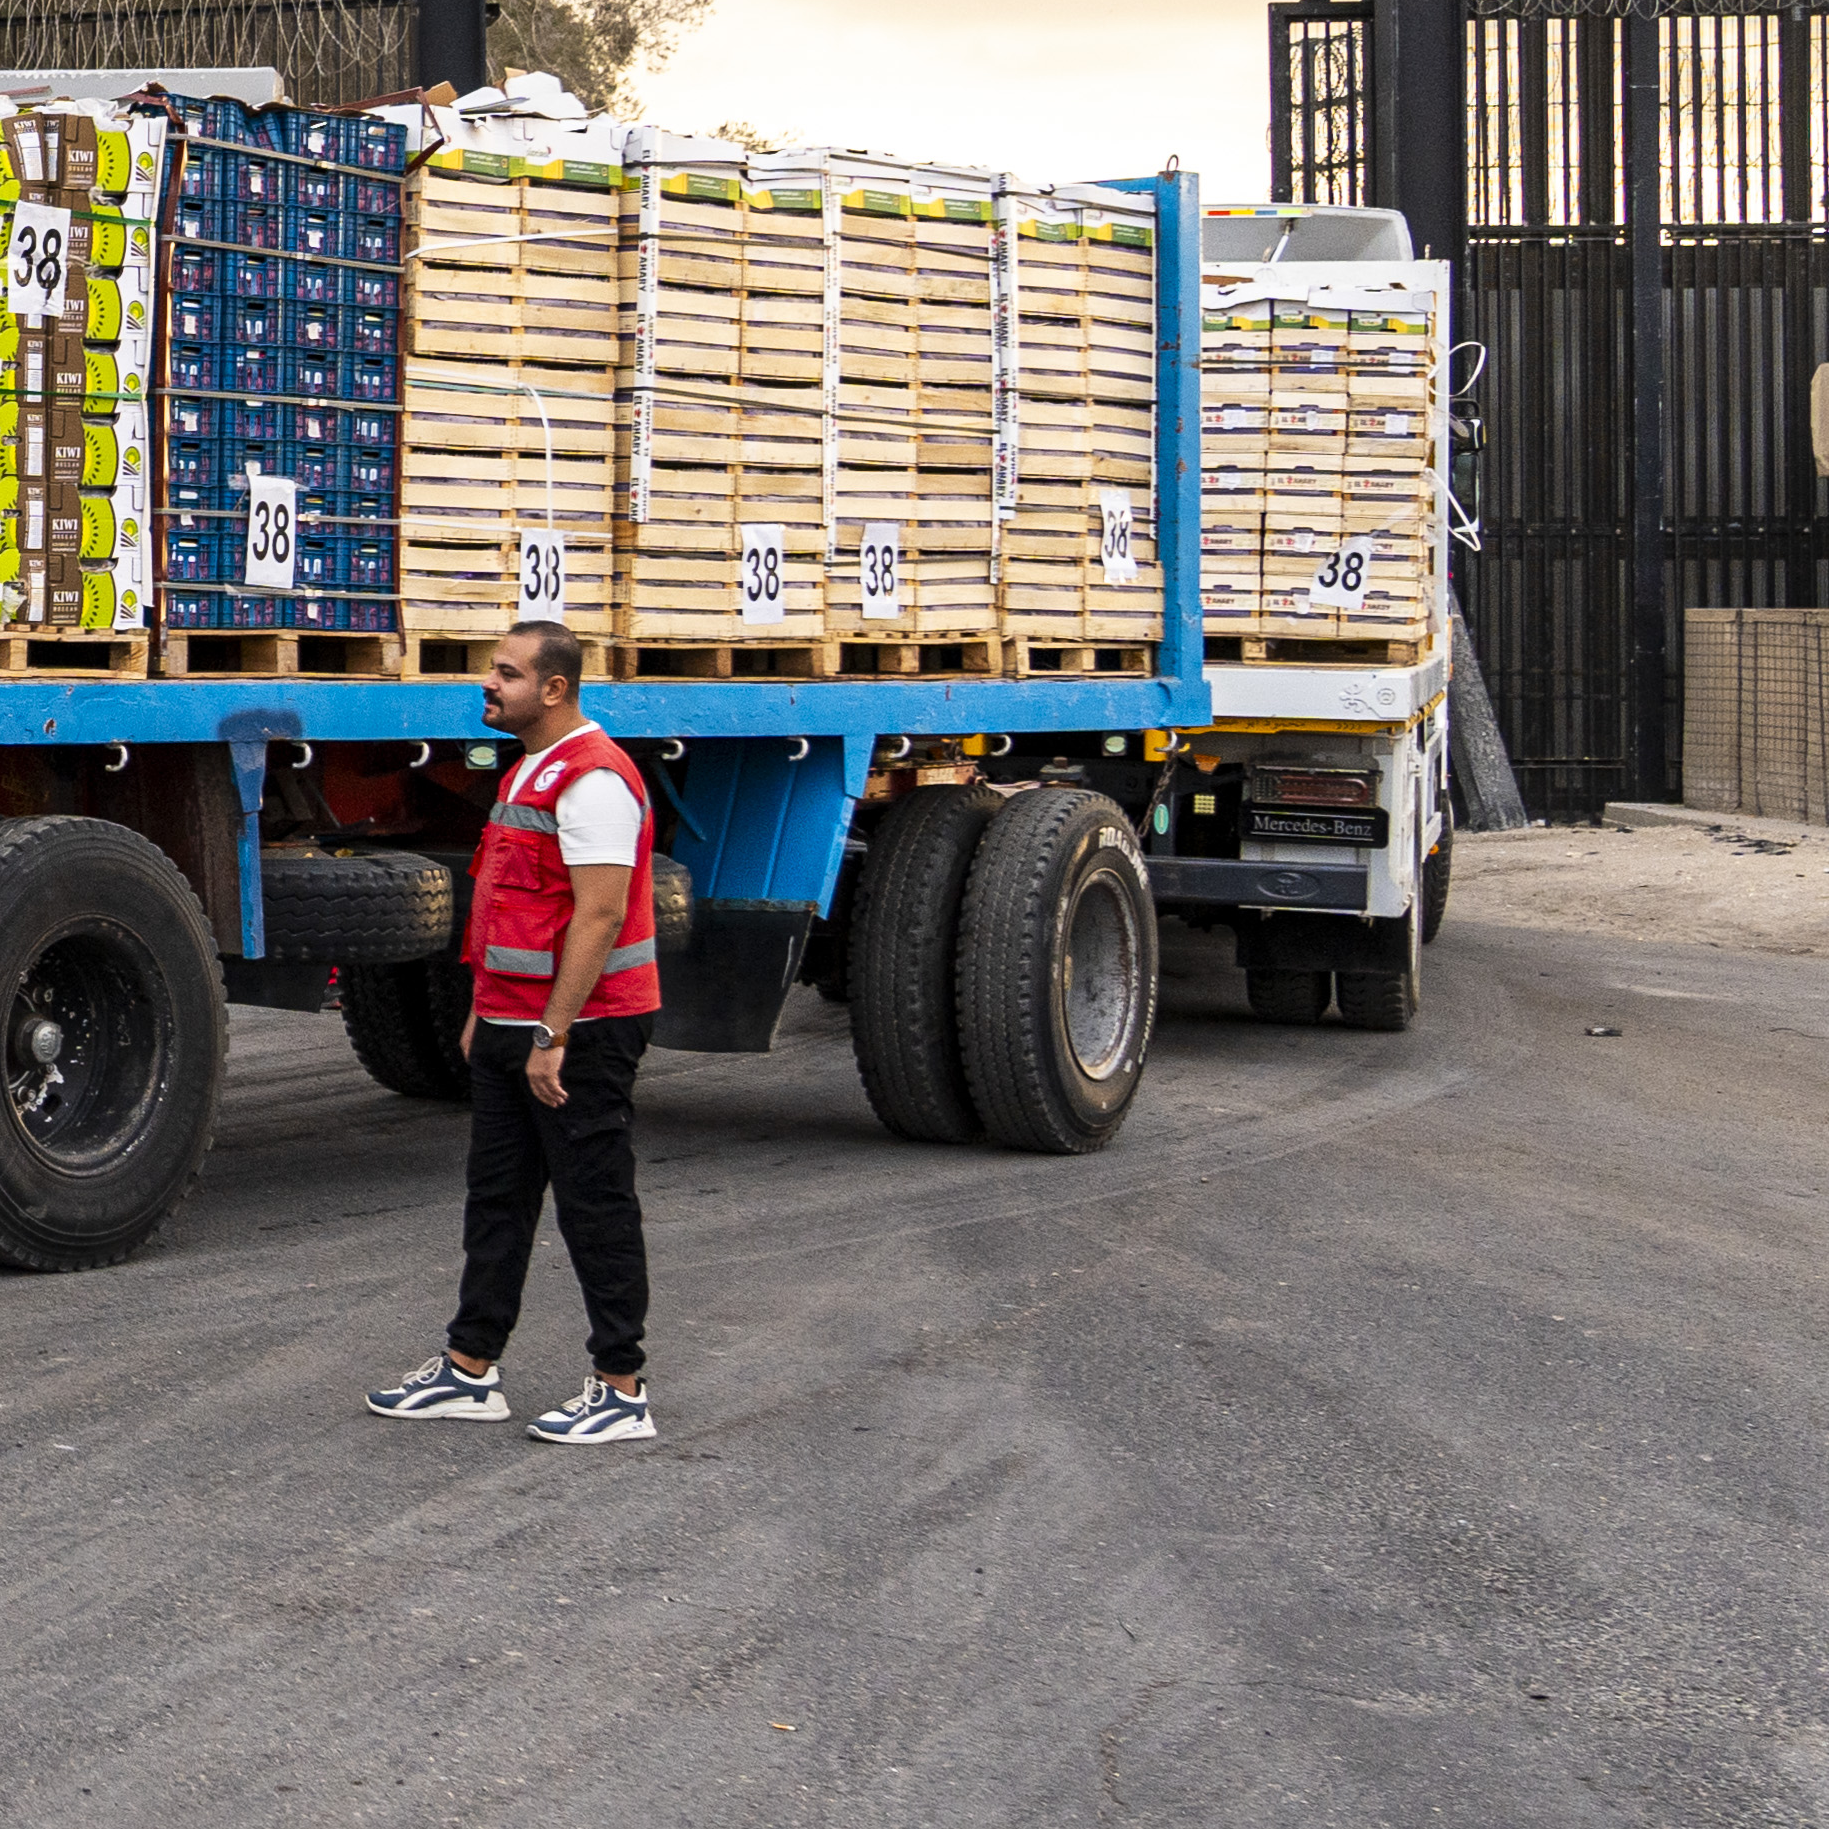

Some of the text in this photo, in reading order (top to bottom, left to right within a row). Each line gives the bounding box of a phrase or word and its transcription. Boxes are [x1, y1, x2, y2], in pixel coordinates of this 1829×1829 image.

[13, 119, 37, 130] KIWI
[68, 150, 94, 163] KIWI
[68, 226, 89, 238] IWI
[14, 226, 62, 290] 38
[56, 372, 82, 385] KIWI
[55, 446, 81, 459] KIWI
[52, 518, 78, 531] KIWI
[252, 501, 290, 564] 38
[1104, 510, 1129, 559] 38
[524, 544, 561, 601] 38
[747, 548, 780, 602] 38
[864, 545, 893, 597] 38
[1318, 552, 1363, 592] 38
[53, 591, 79, 603] KIWI
[1253, 815, 1373, 836] Mercedes-Benz
